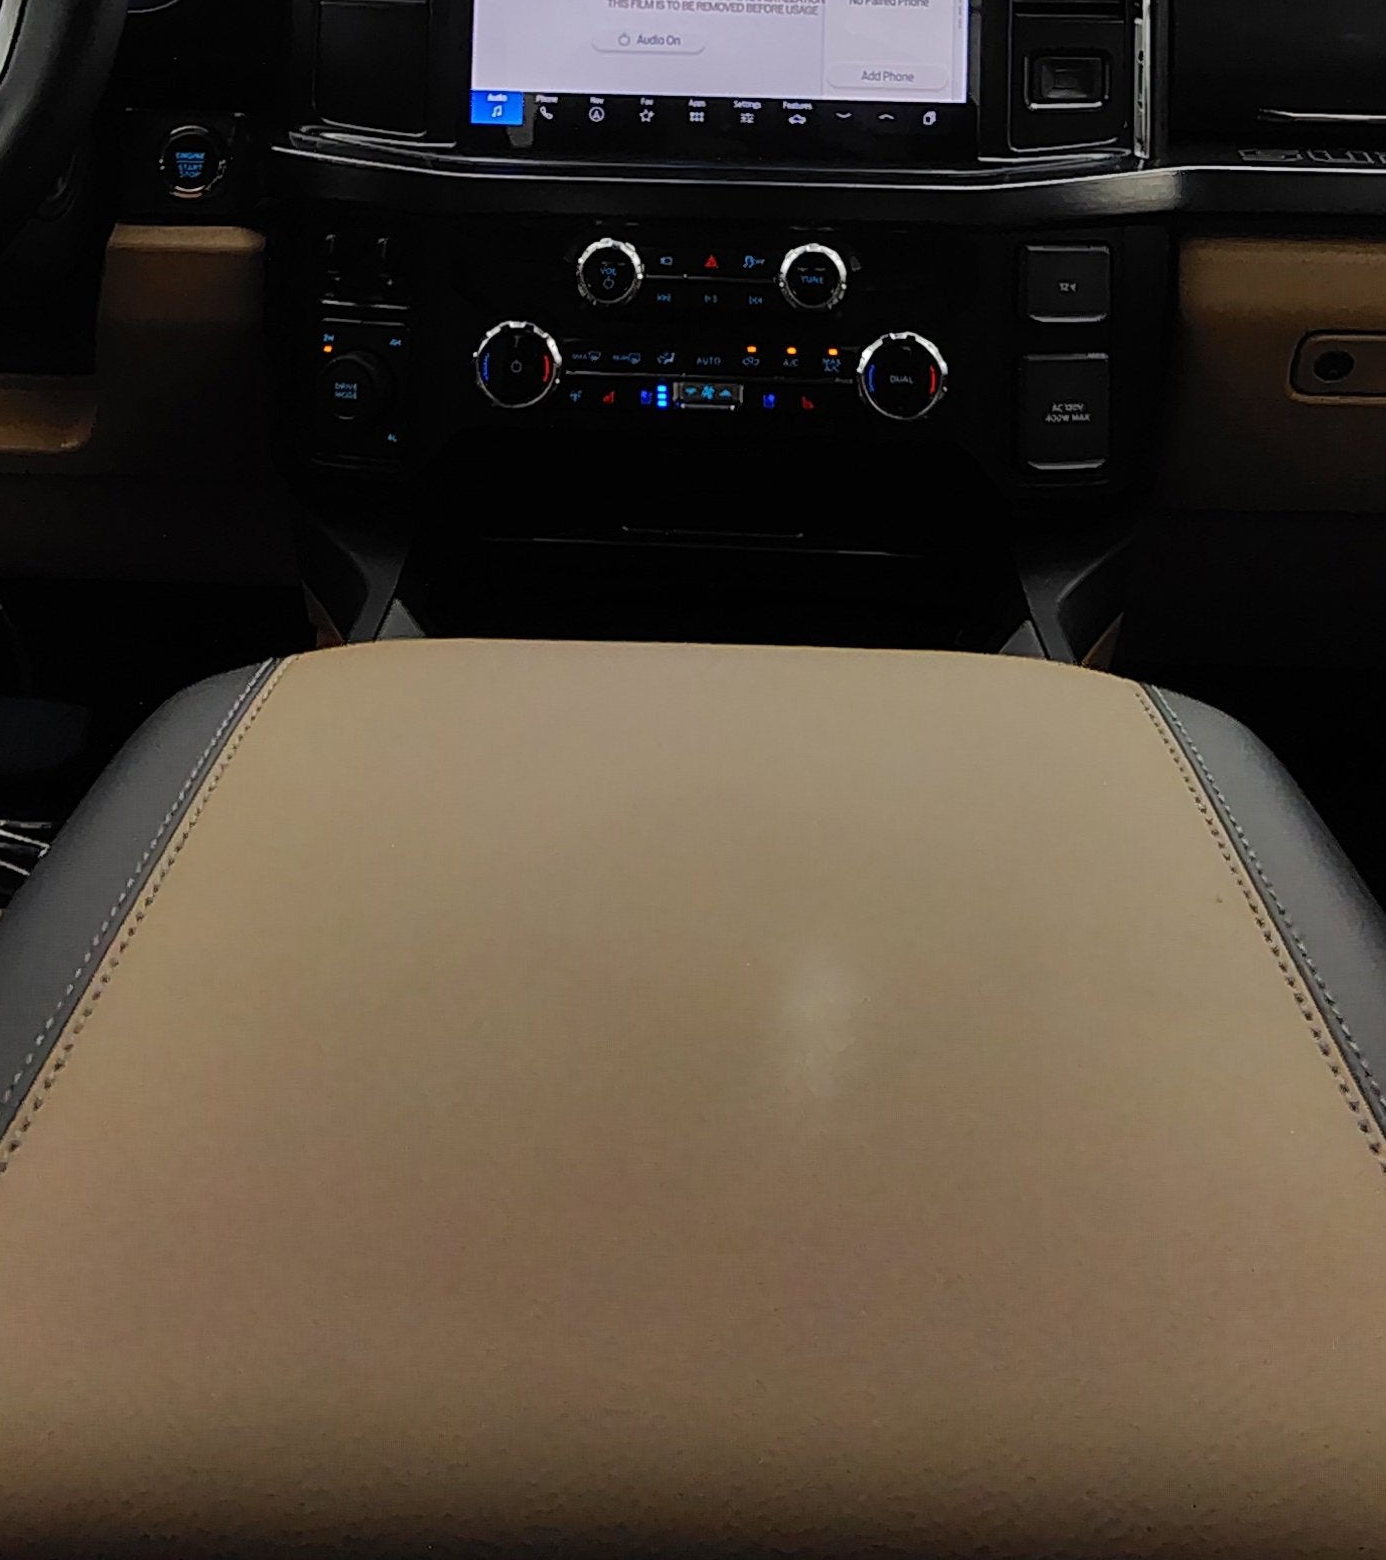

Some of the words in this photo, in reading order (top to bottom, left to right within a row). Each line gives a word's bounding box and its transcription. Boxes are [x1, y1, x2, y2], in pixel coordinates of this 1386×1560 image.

[656, 0, 665, 10] IS
[667, 0, 680, 10] TO
[682, 0, 695, 11] BE
[696, 1, 745, 13] REMOVED
[746, 3, 784, 15] BEFORE
[785, 4, 819, 16] USAGE
[636, 34, 665, 46] Audio
[666, 35, 681, 46] On
[861, 71, 882, 81] Add
[883, 71, 915, 82] Phone
[696, 356, 721, 366] AUTO
